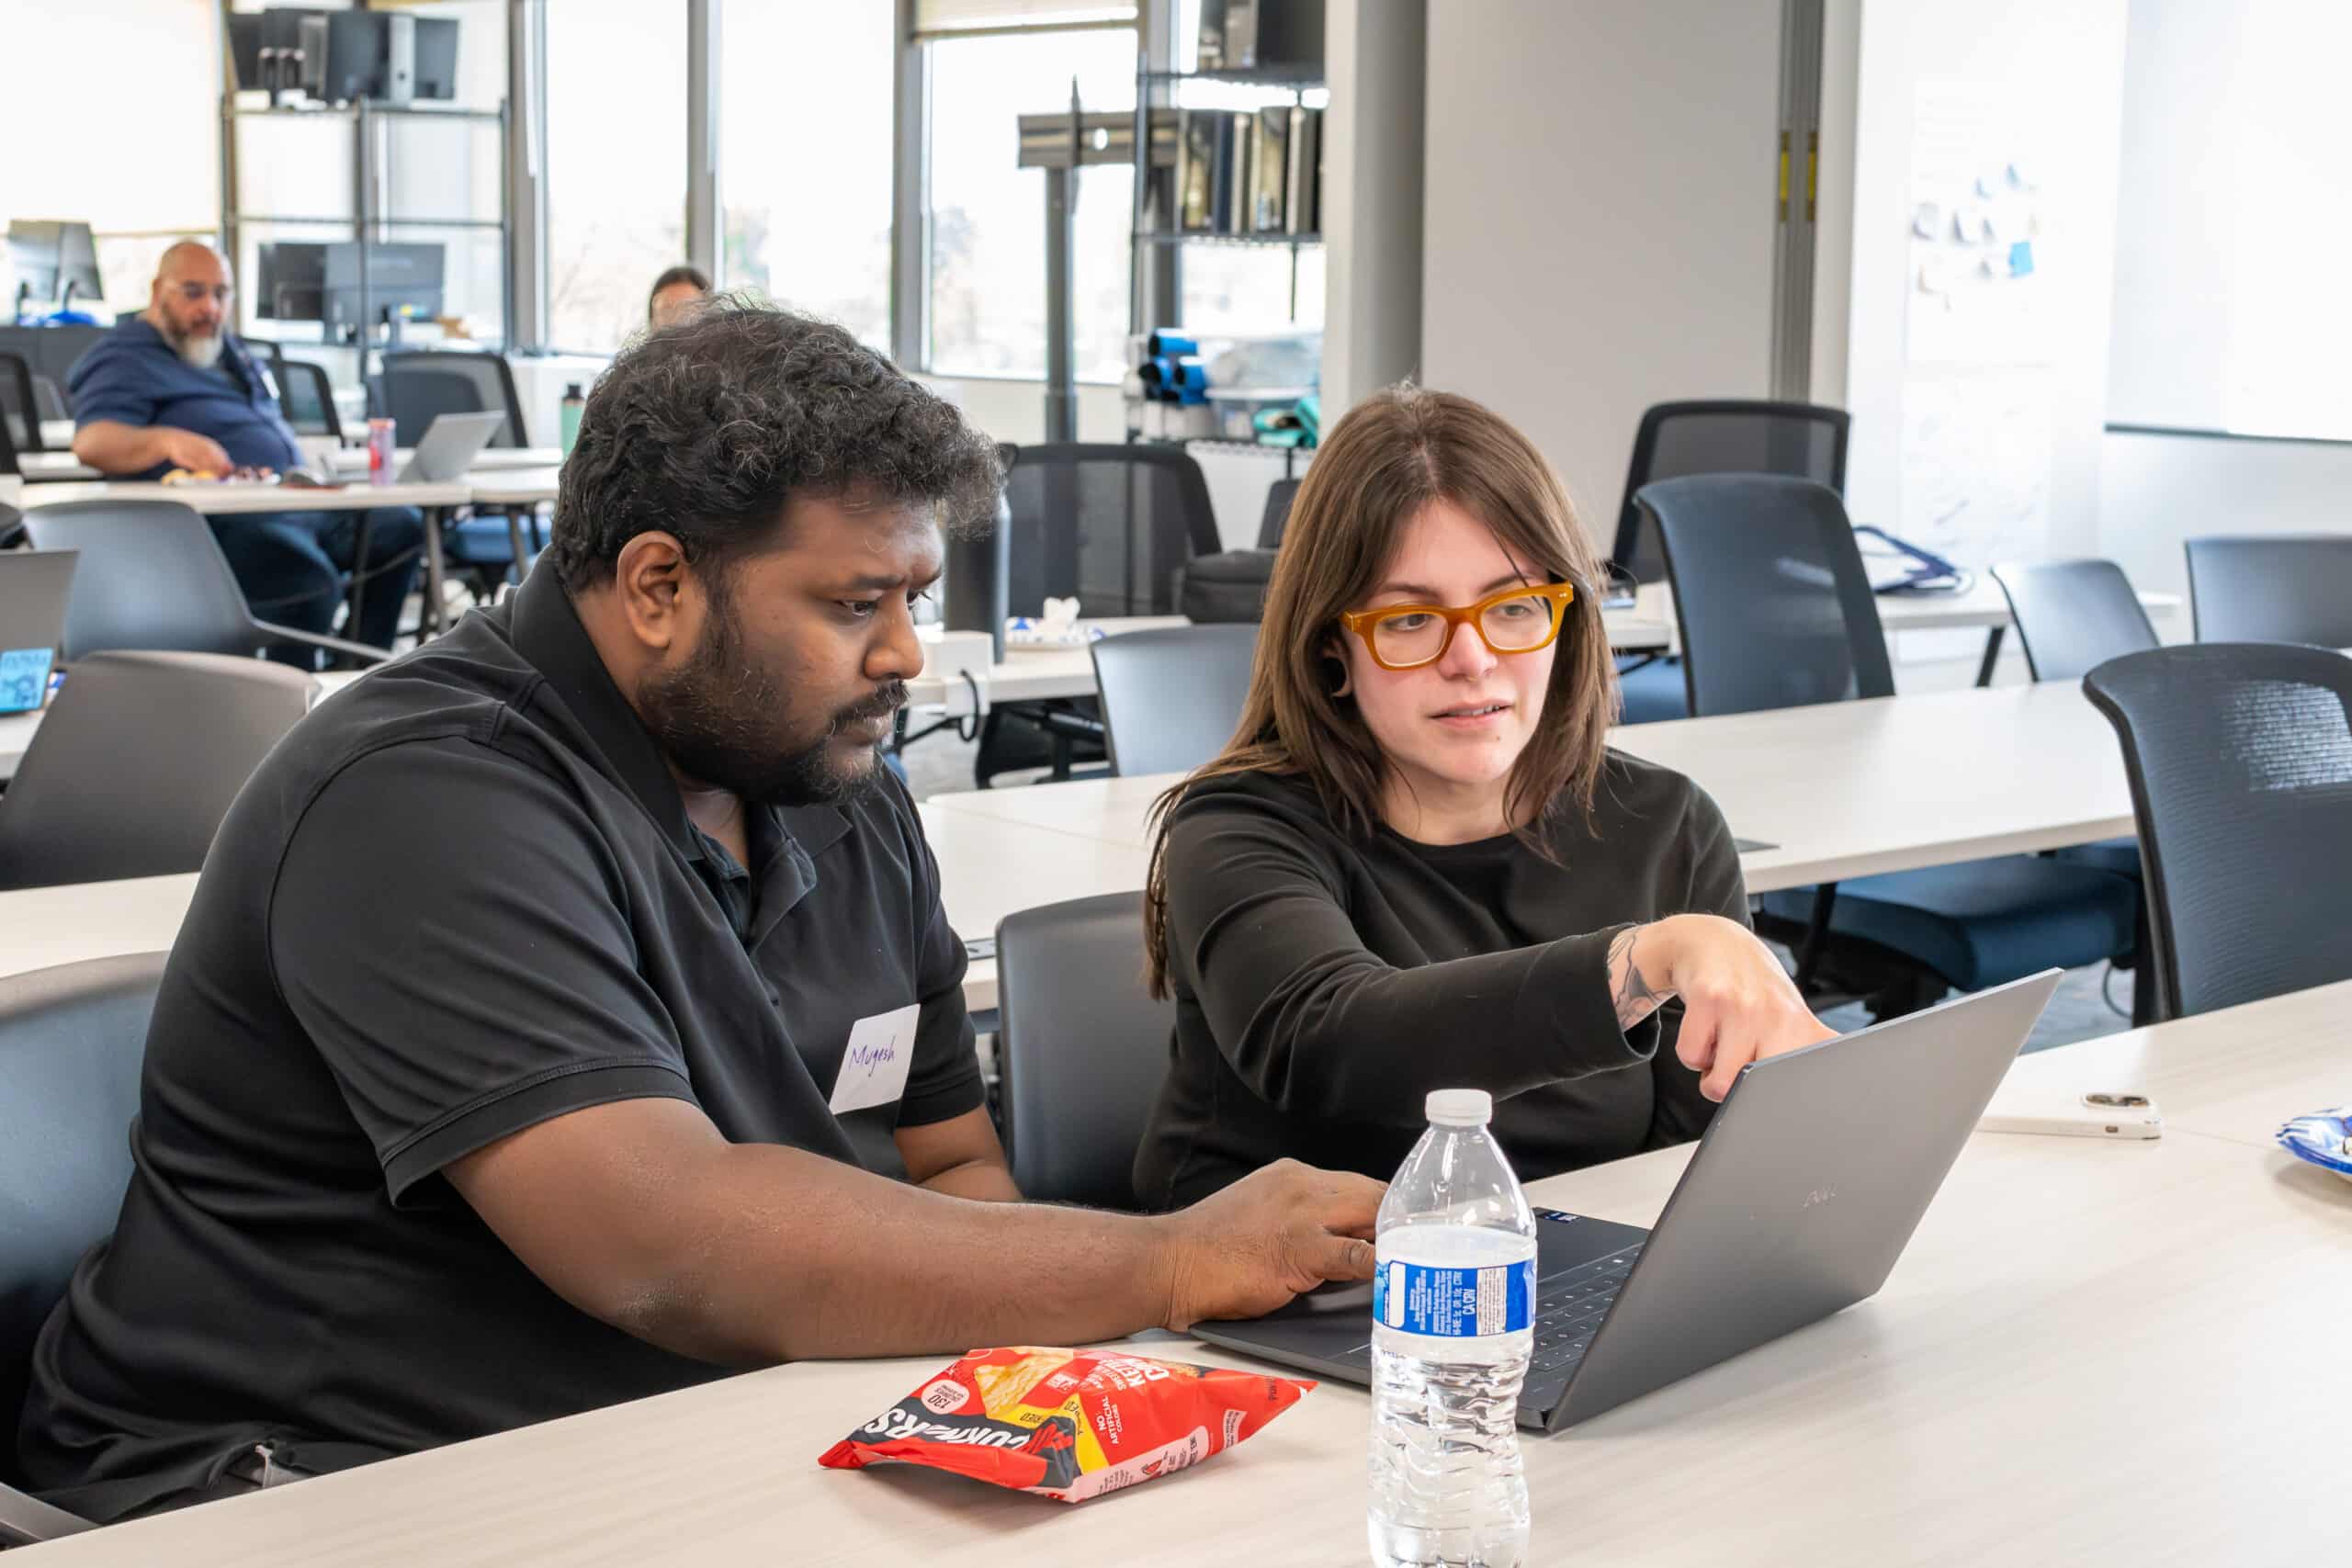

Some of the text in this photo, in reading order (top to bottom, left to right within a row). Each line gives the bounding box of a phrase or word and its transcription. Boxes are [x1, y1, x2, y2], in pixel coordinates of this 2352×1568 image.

[848, 1034, 897, 1077] Mugesh
[1463, 1288, 1476, 1315] CA CRV
[927, 1394, 950, 1409] 130
[1096, 1415, 1106, 1431] NO
[1102, 1395, 1120, 1445] ARTIFICIAL
